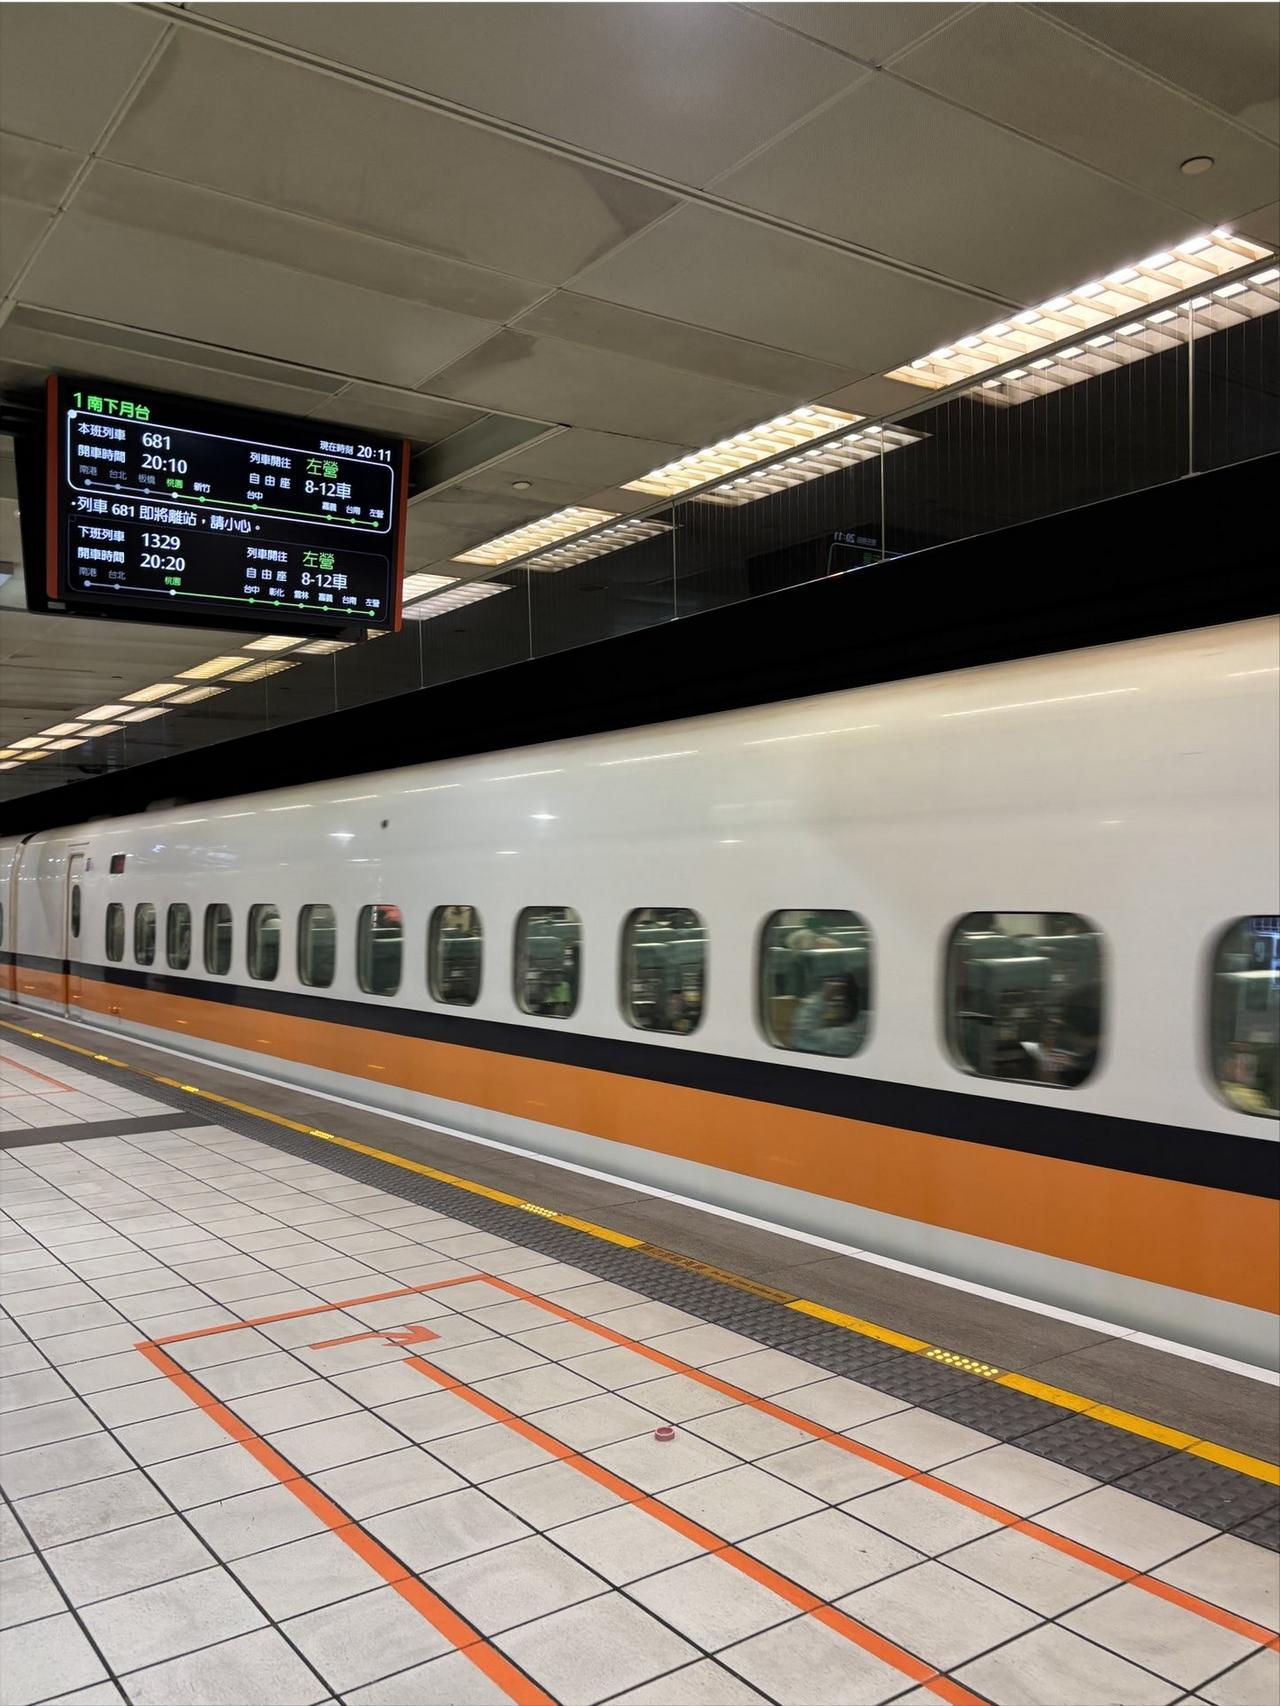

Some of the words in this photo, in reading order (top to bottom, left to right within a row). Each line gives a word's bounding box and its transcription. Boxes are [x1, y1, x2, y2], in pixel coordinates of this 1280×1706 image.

[73, 392, 82, 408] 1
[87, 395, 150, 421] 南下月台
[78, 423, 126, 441] 本班列車
[142, 432, 171, 450] 681
[78, 444, 126, 464] 開車時間
[141, 453, 188, 474] 20:10
[250, 451, 292, 470] 列車開往
[306, 457, 339, 479] 左營
[357, 445, 391, 462] 20:11
[246, 490, 264, 501] 台中
[305, 480, 352, 500] 8-12車
[77, 496, 108, 514] 列車
[111, 503, 135, 518] 681
[77, 525, 125, 543] 下班列車
[140, 532, 181, 551] 1329
[77, 547, 125, 564] 開車時間
[140, 553, 186, 572] 20:20
[247, 547, 288, 563] 列車開往
[302, 550, 335, 571] 左營
[243, 584, 260, 595] 台中
[301, 572, 348, 591] 8-12車
